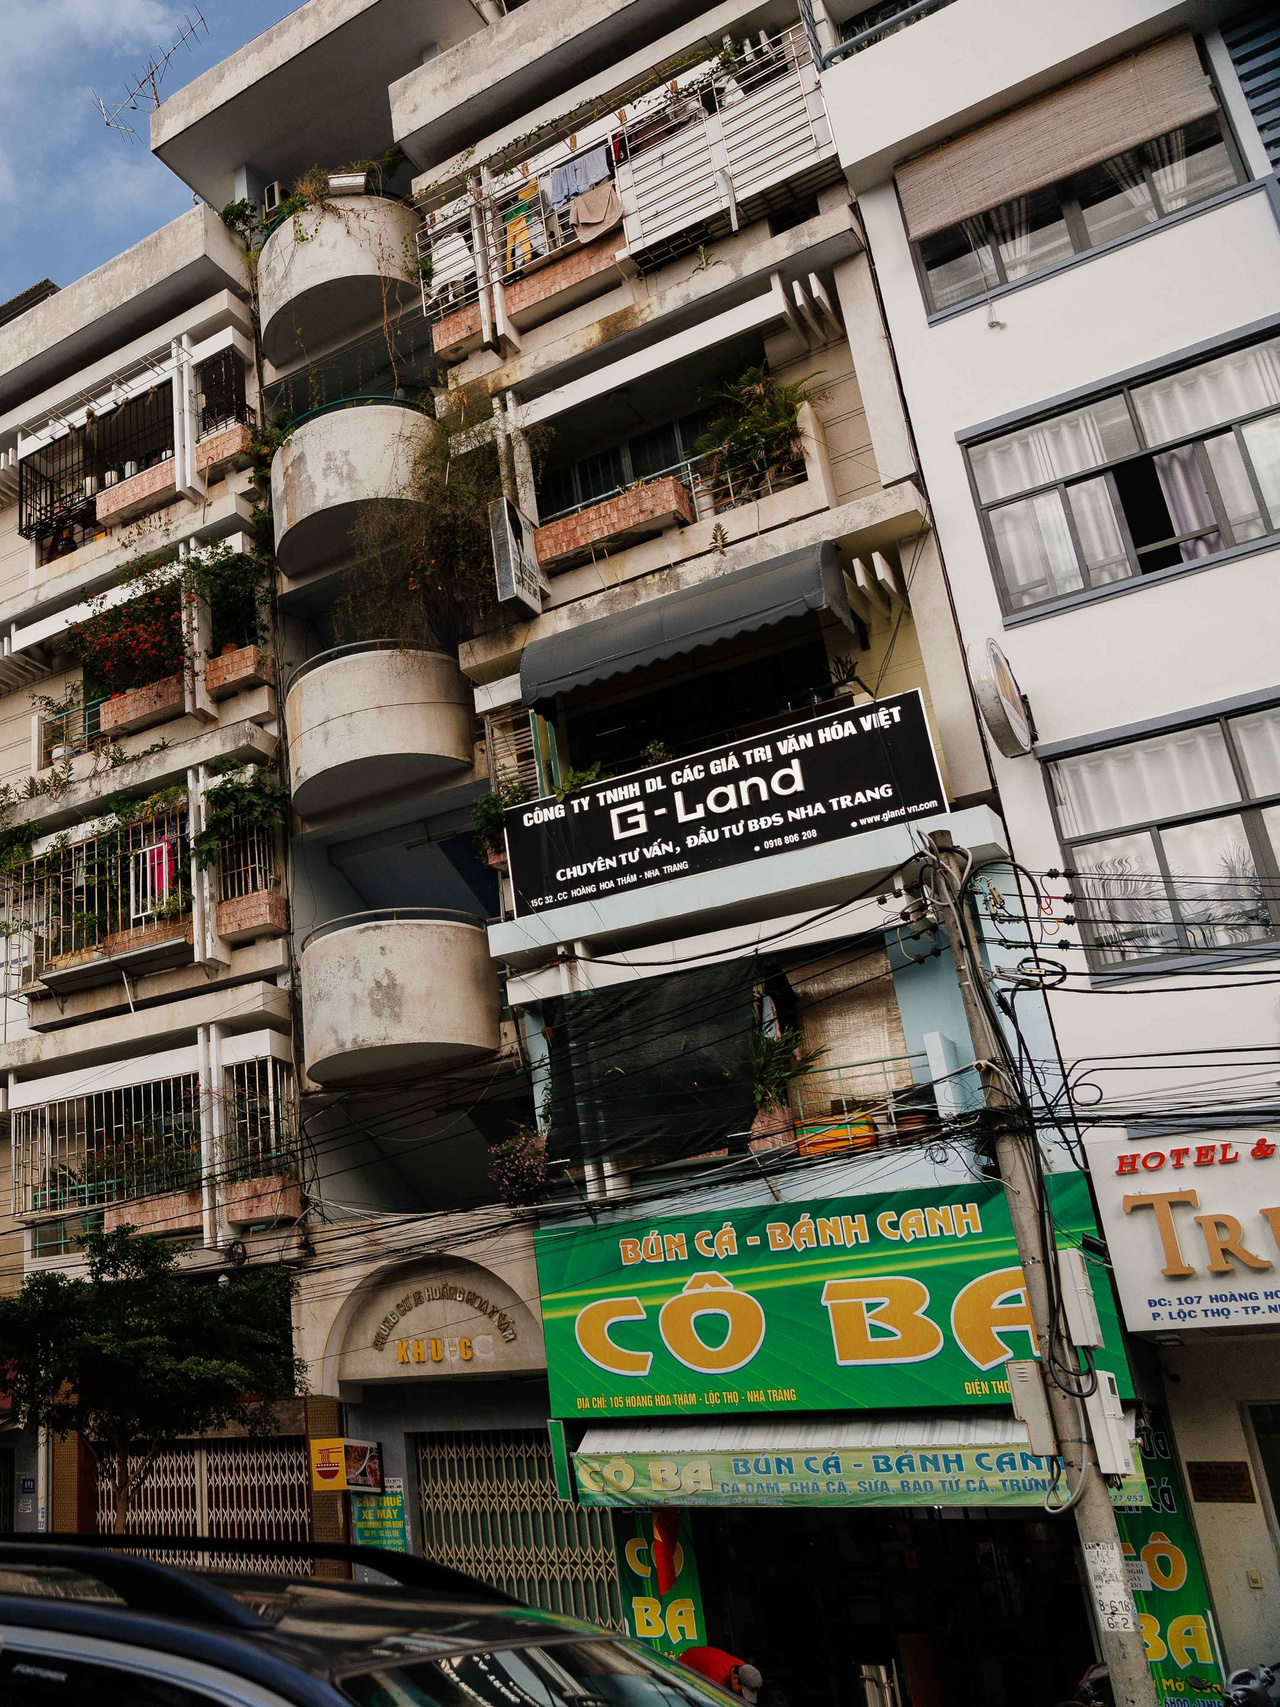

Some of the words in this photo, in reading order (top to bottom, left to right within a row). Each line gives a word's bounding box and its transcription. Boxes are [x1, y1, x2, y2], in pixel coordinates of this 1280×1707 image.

[523, 804, 565, 827] CÔNG
[571, 796, 590, 815] TY
[597, 782, 640, 806] TNHH
[645, 776, 666, 793] DL
[671, 764, 704, 785] CÁC
[710, 752, 739, 775] GIÁ
[743, 744, 772, 762] TRỊ
[776, 733, 813, 755] VĂN
[818, 720, 857, 744] HÓA
[859, 706, 901, 731] VIỆT
[556, 856, 616, 881] CHUYÊN
[618, 847, 640, 863] TƯ
[686, 826, 719, 848] ĐẦU
[721, 820, 744, 839] TƯ
[748, 812, 784, 833] BĐS
[787, 802, 826, 821] NHA
[828, 783, 893, 813] TRANG
[763, 836, 783, 850] 0918
[784, 832, 800, 845] 806
[802, 828, 818, 841] 208
[557, 891, 568, 901] CC
[571, 883, 597, 897] HOÀNG
[599, 879, 615, 890] HOA
[616, 872, 638, 886] THÁM
[644, 868, 660, 879] NHA
[662, 860, 689, 874] TRANG
[1115, 1143, 1239, 1174] HOTEL
[1251, 1138, 1276, 1159] &
[620, 1230, 688, 1265] BÚN
[695, 1222, 738, 1260] CÁ
[766, 1213, 869, 1252] BÁNH
[877, 1203, 983, 1243] CANH
[1148, 1298, 1172, 1308] ĐC:
[1176, 1296, 1202, 1306] 107
[1209, 1291, 1259, 1304] HOÀNG
[1263, 1290, 1280, 1300] HO
[1152, 1312, 1163, 1321] P.
[1168, 1309, 1197, 1322] LỘC
[1201, 1307, 1231, 1319] THỌ
[575, 1272, 766, 1377] CÔ
[821, 1266, 1041, 1372] BA
[577, 1397, 590, 1411] ĐỊA
[609, 1396, 624, 1408] 105
[625, 1393, 653, 1408] HOÀNG
[655, 1395, 672, 1407] HOA
[672, 1391, 697, 1406] THÁM
[704, 1389, 720, 1407] LỘC
[722, 1391, 739, 1406] THỌ
[747, 1390, 765, 1403] NHA
[766, 1388, 797, 1402] TRANG
[964, 1379, 989, 1397] ĐIỆN
[991, 1380, 1011, 1394] THO
[579, 1456, 635, 1492] CÔ
[648, 1460, 714, 1495] BA
[731, 1453, 796, 1476] BÚN
[803, 1451, 843, 1477] CÁ
[872, 1450, 964, 1475] BÁNH
[356, 1496, 376, 1508] CHO
[378, 1494, 402, 1507] THUÊ
[721, 1479, 739, 1494] CÁ
[790, 1477, 822, 1494] CHẢ
[901, 1478, 934, 1493] BAO
[939, 1475, 963, 1493] TỬ
[362, 1509, 374, 1519] XE
[376, 1507, 398, 1519] MÁY
[1121, 1531, 1187, 1591] Ô
[632, 1597, 697, 1644] BA
[1138, 1613, 1214, 1669] BA
